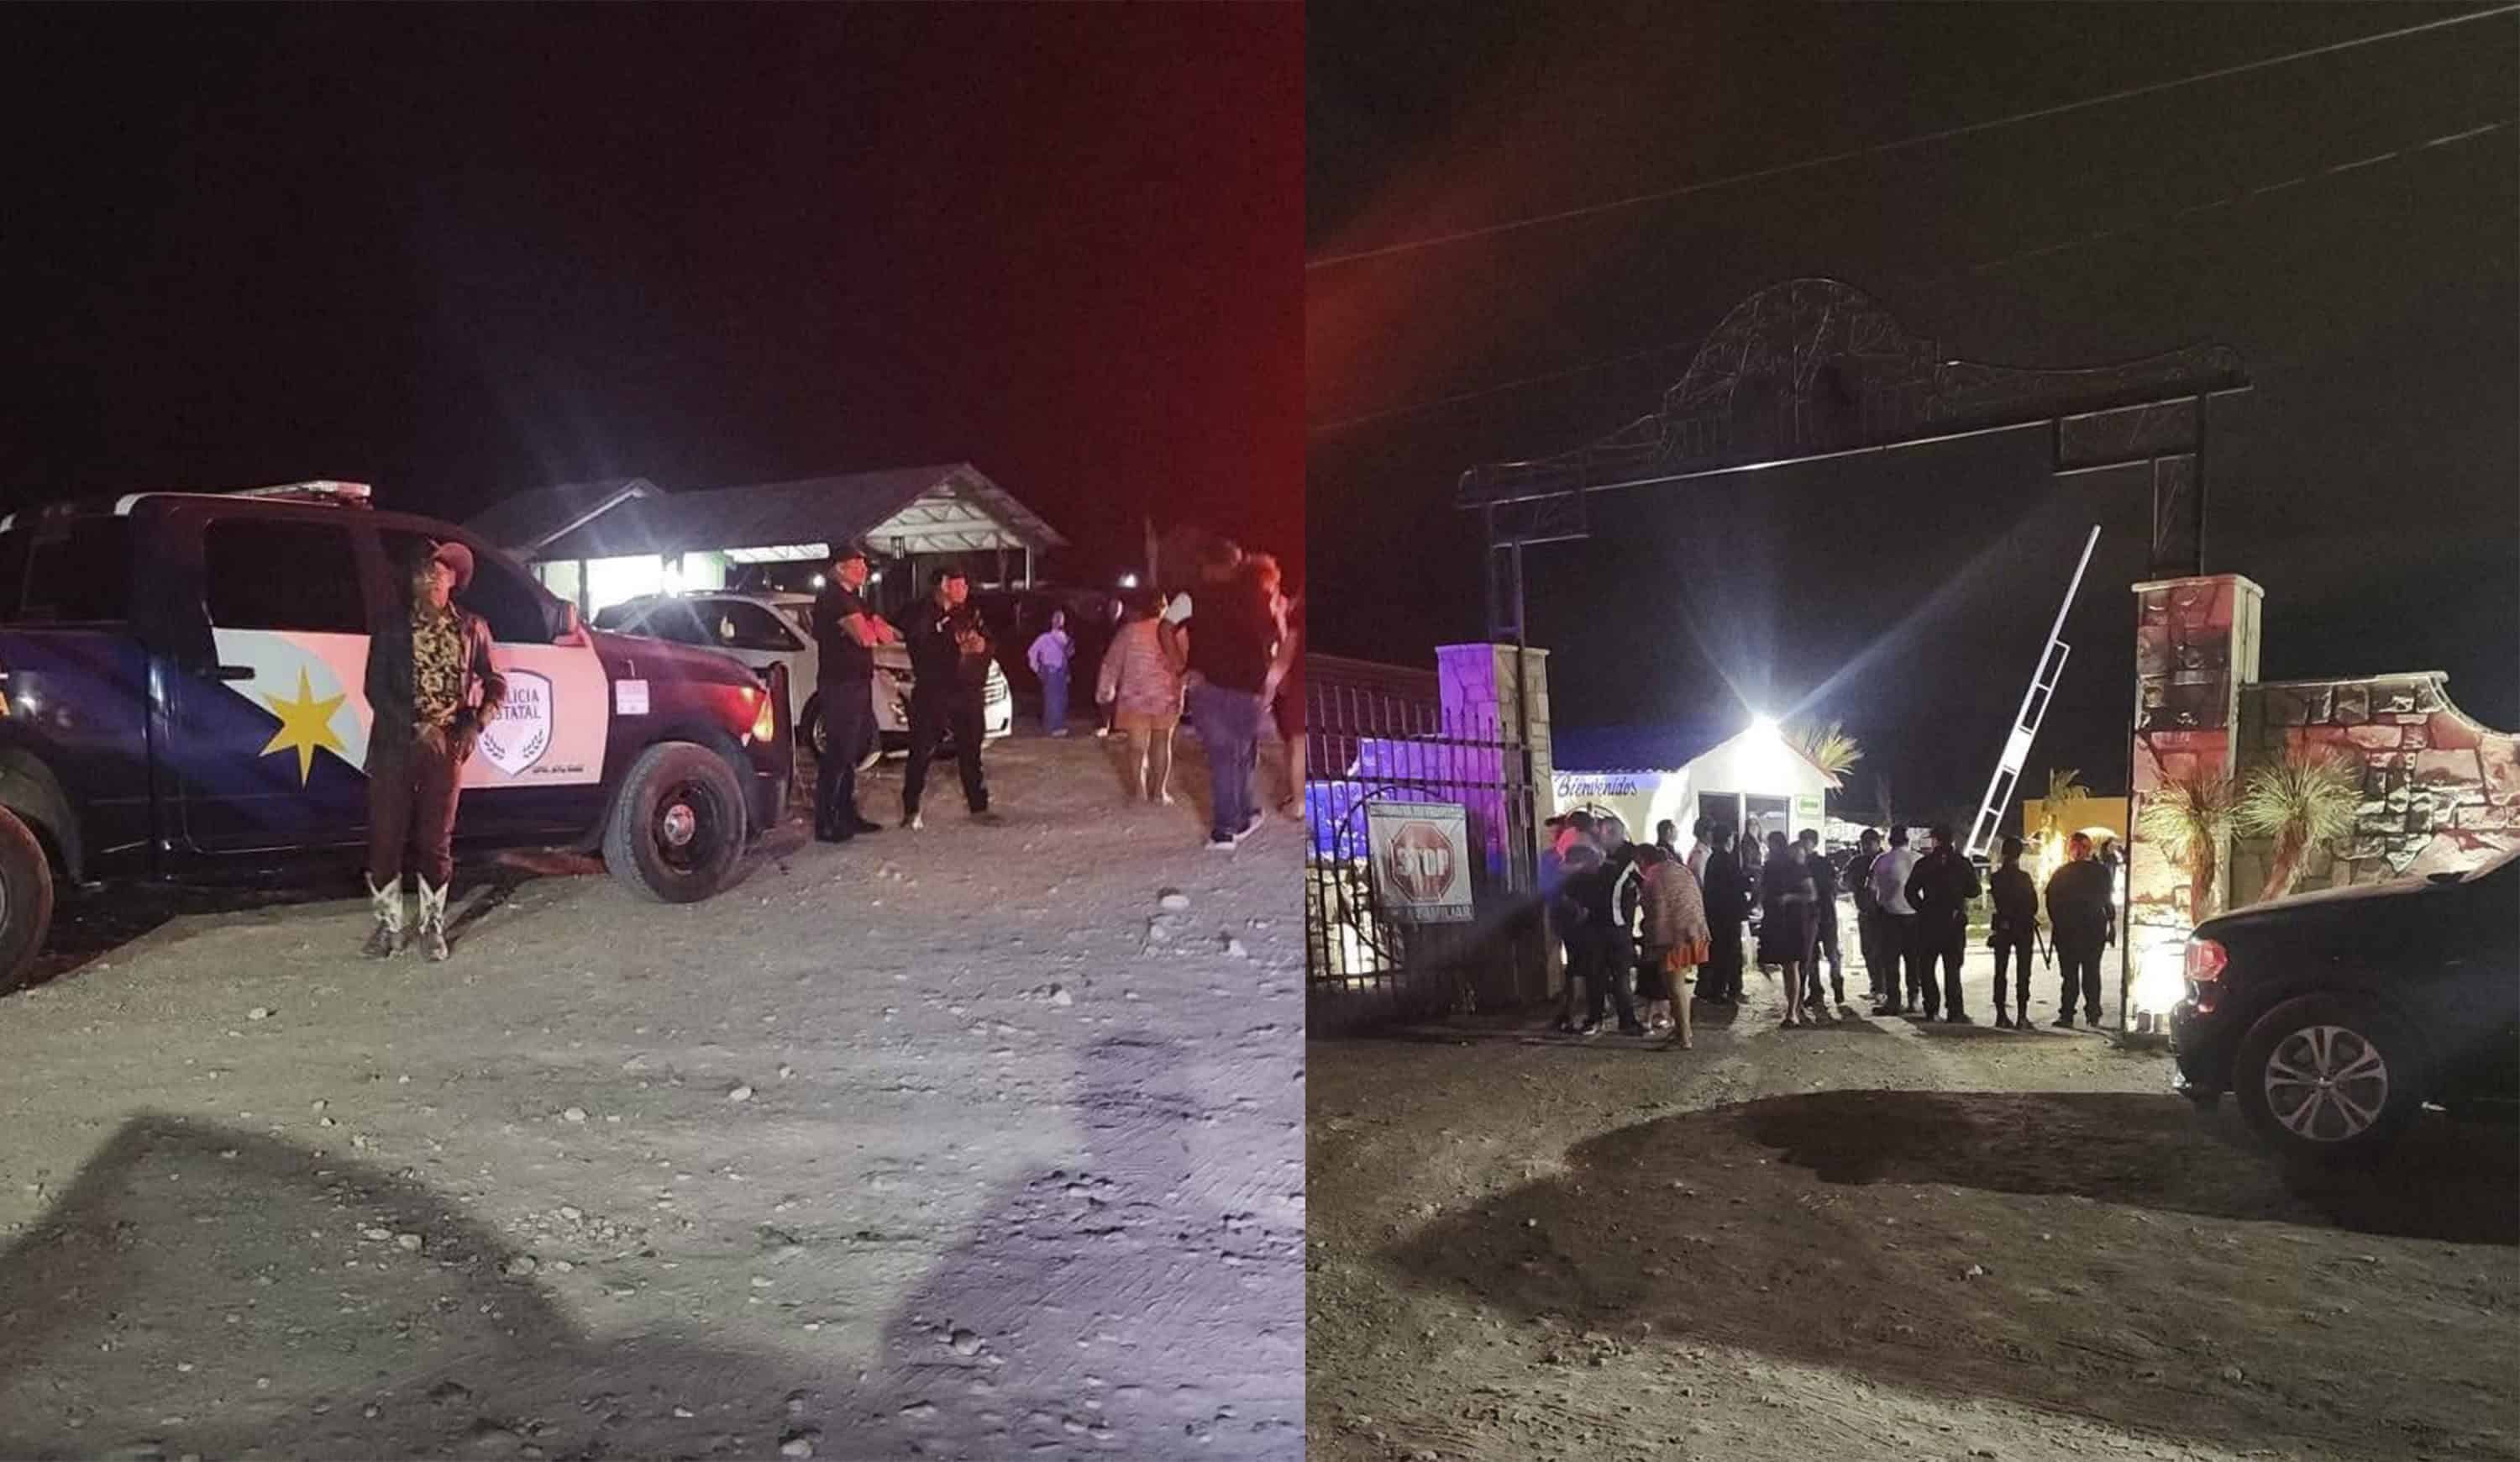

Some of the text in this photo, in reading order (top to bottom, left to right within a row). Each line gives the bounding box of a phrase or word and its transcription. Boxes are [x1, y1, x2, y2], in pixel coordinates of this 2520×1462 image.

[506, 688, 539, 703] LICIA
[491, 705, 542, 720] STATAL
[1555, 775, 1638, 797] Bienvenidos
[1397, 847, 1449, 876] STOP
